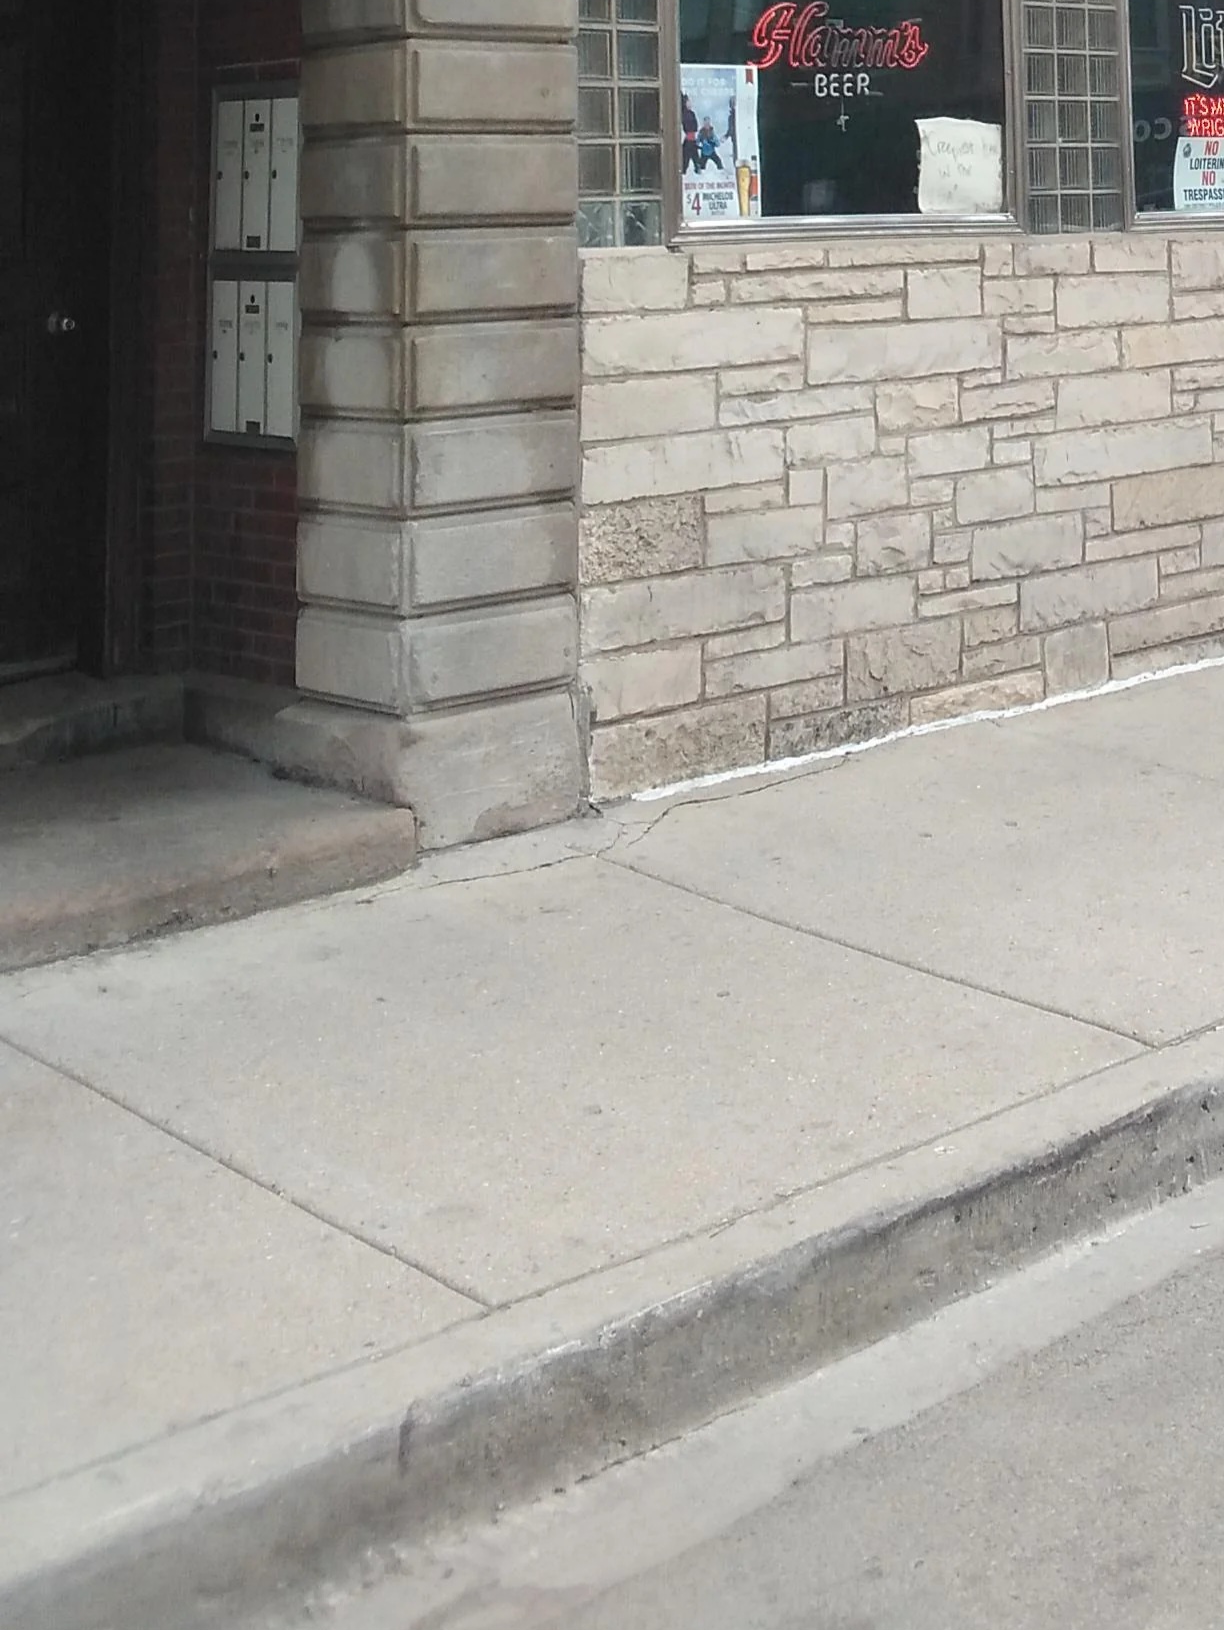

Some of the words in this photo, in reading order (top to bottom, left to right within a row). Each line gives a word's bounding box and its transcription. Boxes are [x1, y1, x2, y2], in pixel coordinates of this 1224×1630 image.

[815, 73, 870, 97] BEER
[1184, 94, 1208, 115] IT'S
[1204, 140, 1219, 156] NO
[1201, 171, 1216, 186] NO
